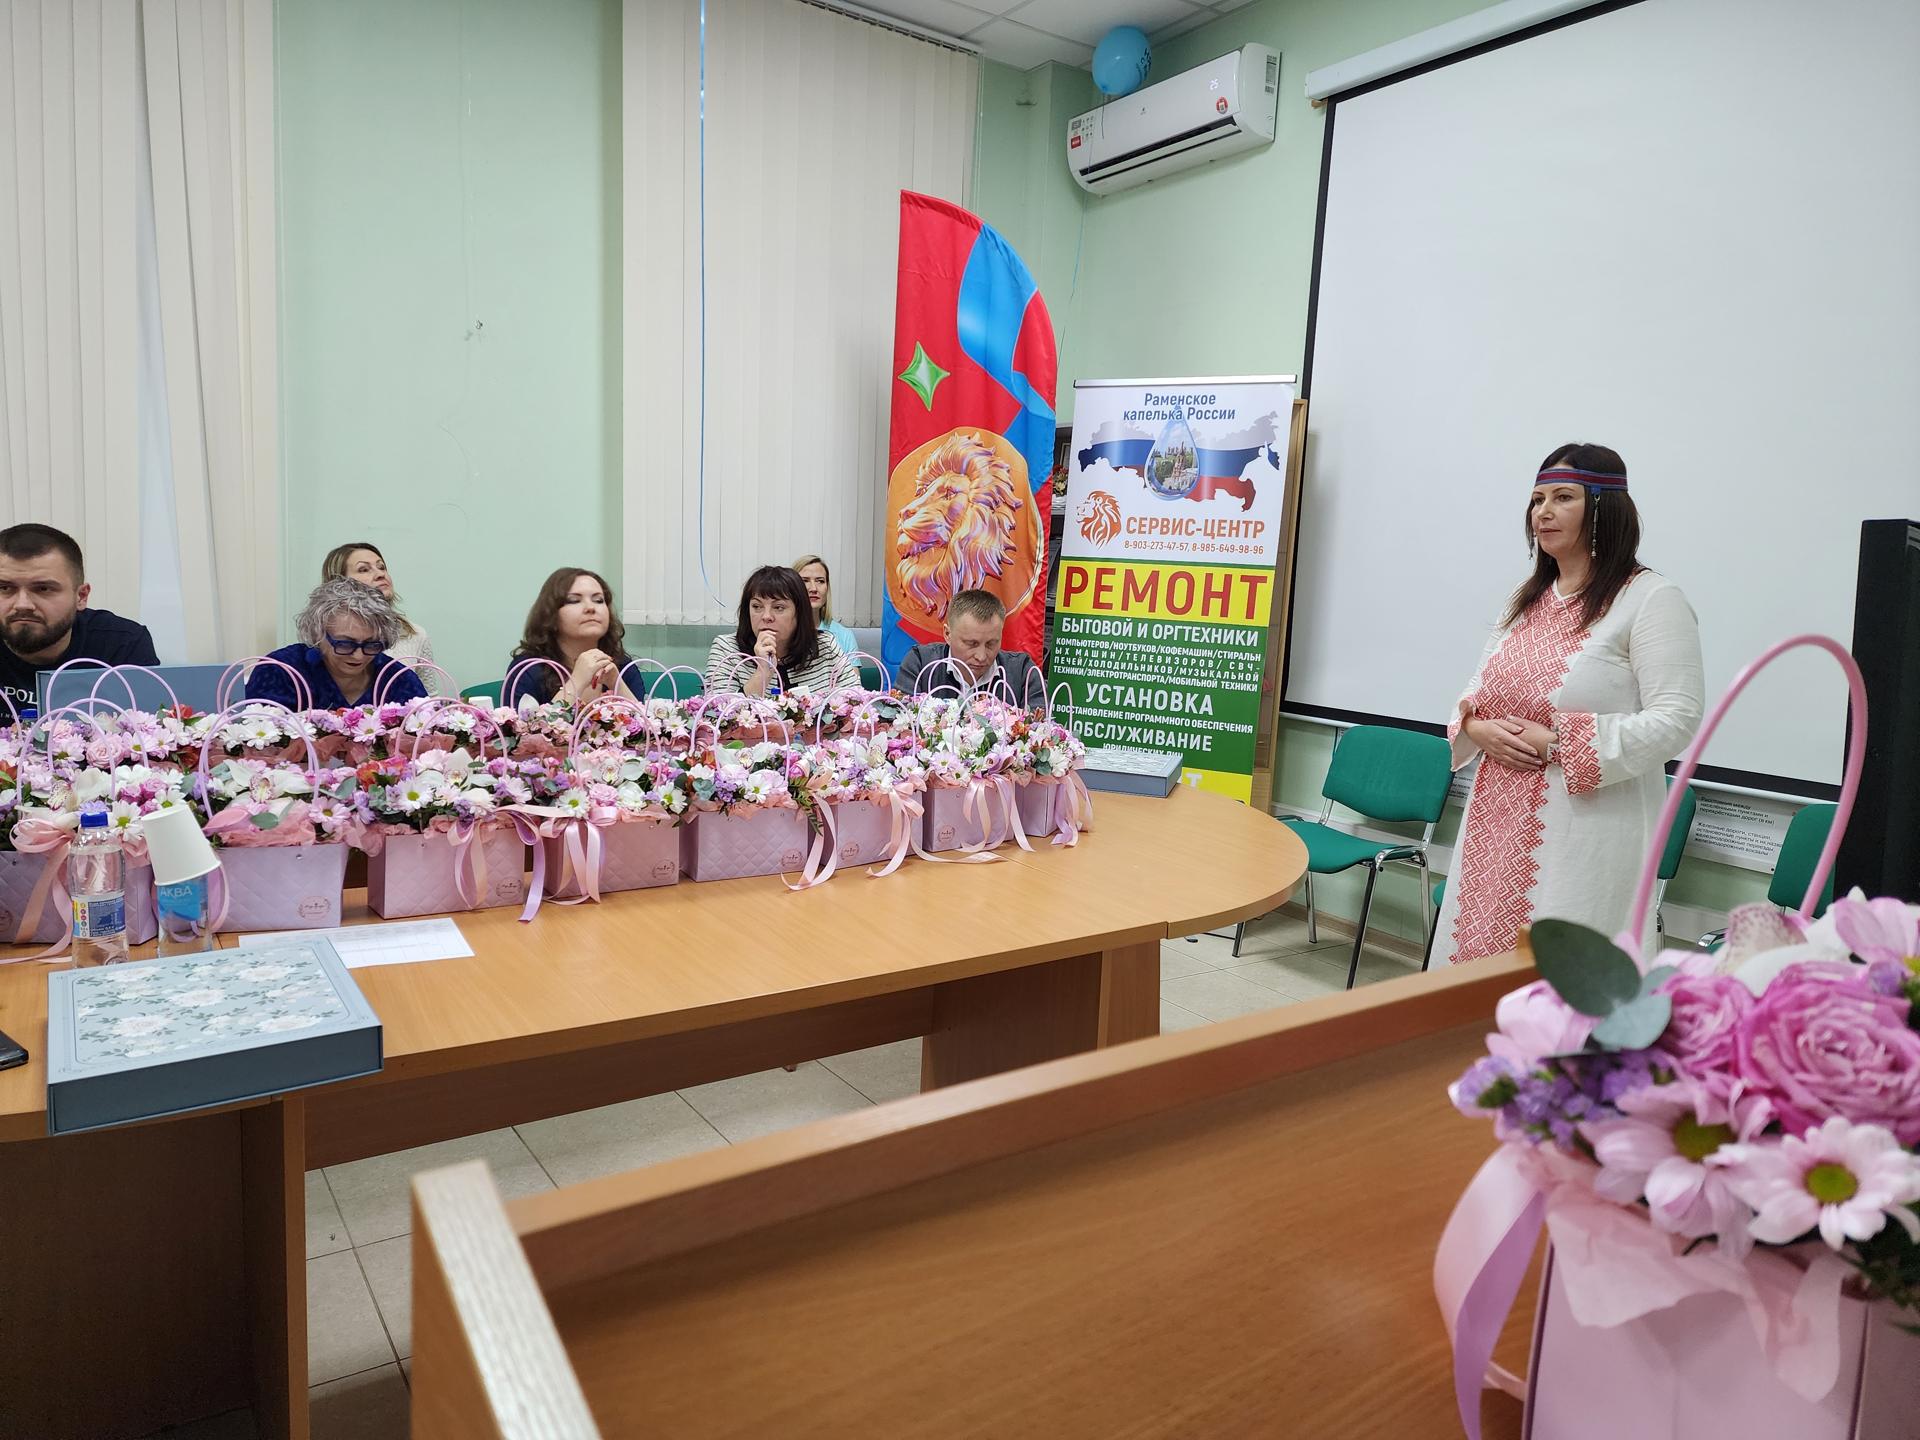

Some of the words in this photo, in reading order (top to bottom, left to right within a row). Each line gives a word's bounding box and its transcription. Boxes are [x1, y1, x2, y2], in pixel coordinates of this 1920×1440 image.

[1144, 393, 1216, 406] Раменское
[1123, 410, 1183, 421] капелька
[1187, 407, 1236, 420] России
[1126, 516, 1265, 539] СЕРВИС-ЦЕНТР
[1124, 540, 1190, 553] 8-903-273-47-57,
[1191, 543, 1264, 555] 8-985-649-98-96
[1062, 565, 1268, 620] РЕМОНТ
[1061, 617, 1133, 638] БЫТОВОЙ
[1137, 623, 1149, 639] И
[1152, 623, 1259, 647] ОРГТЕХНИКИ
[1221, 681, 1258, 692] ТЕХНИКИ
[1085, 682, 1214, 716] УСТАНОВКА
[1124, 711, 1190, 727] ПРОГРАММНОГО
[1191, 719, 1254, 734] ОБЕСПЕЧЕНИЯ
[1073, 720, 1213, 752] ОБСЛУЖИВАНИЕ
